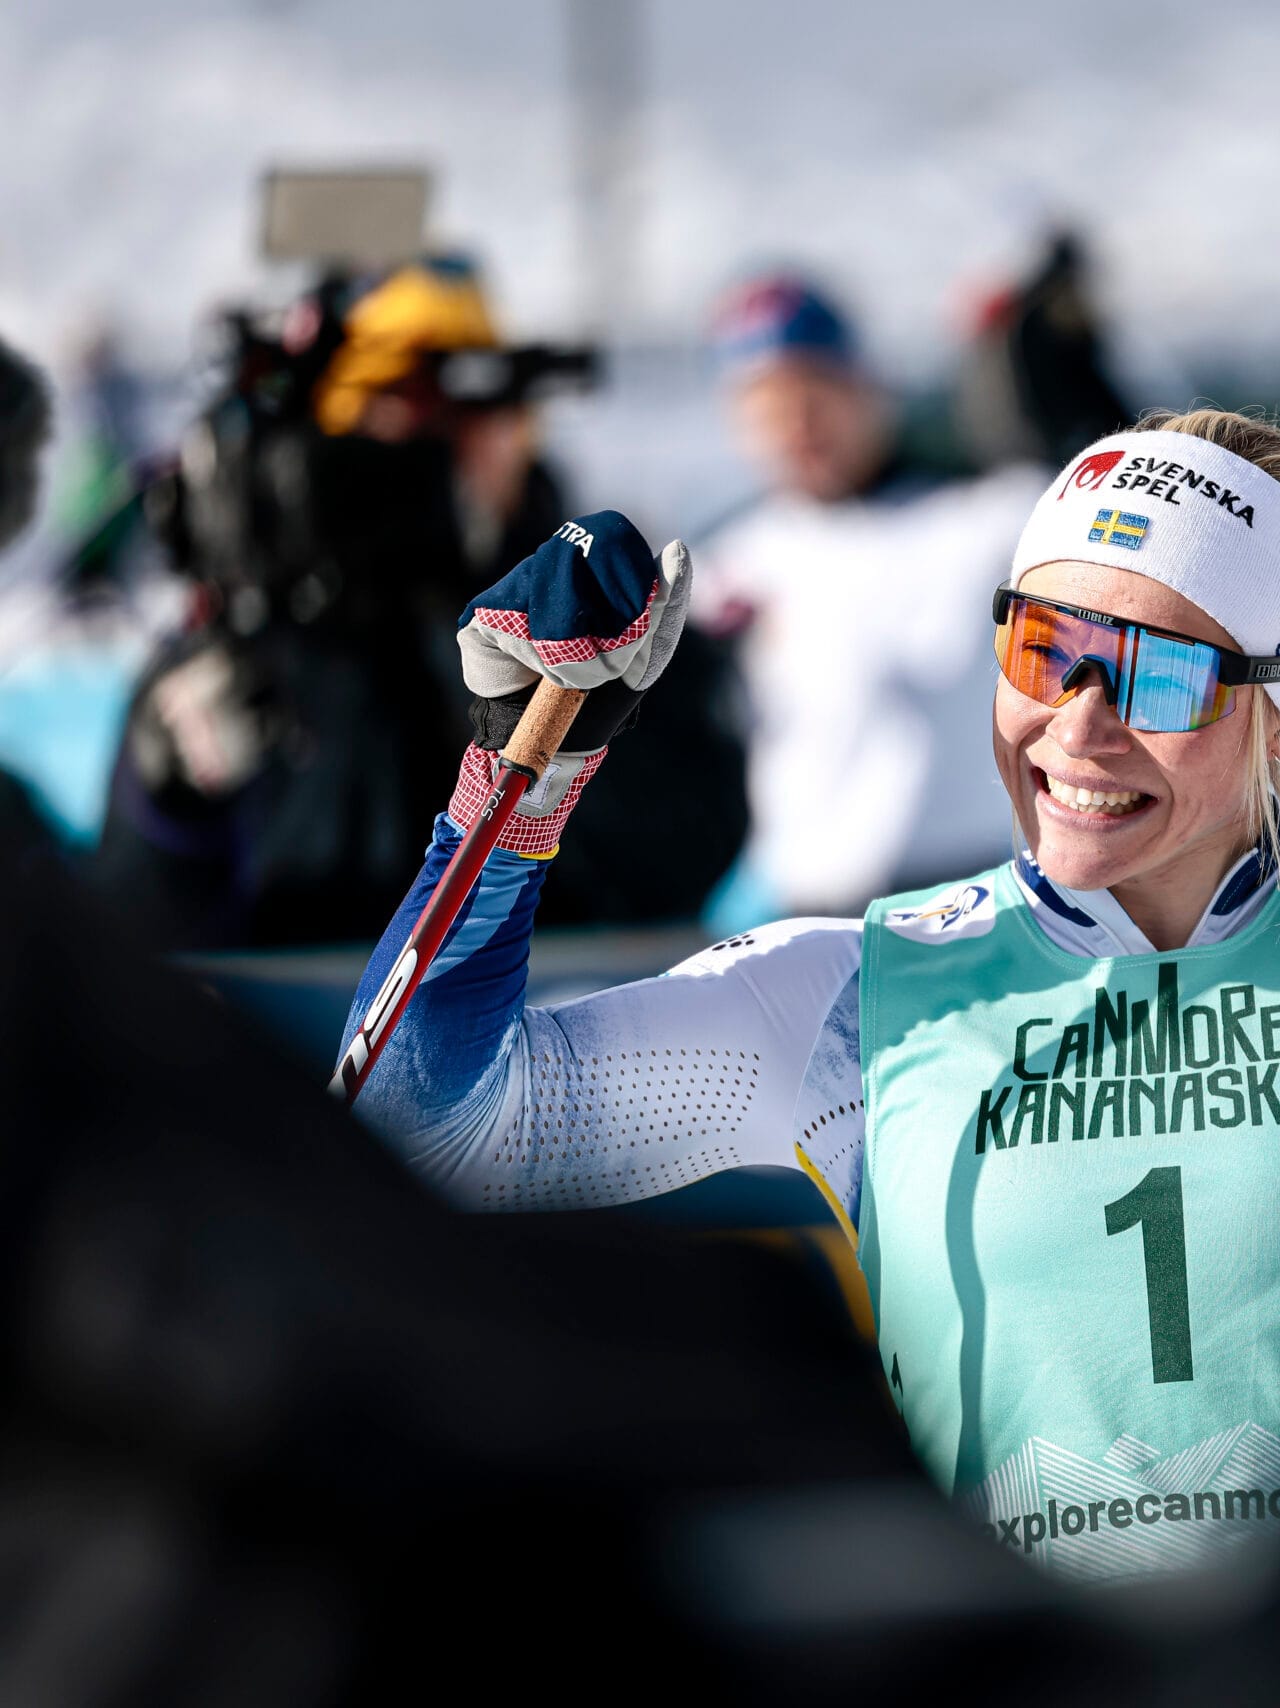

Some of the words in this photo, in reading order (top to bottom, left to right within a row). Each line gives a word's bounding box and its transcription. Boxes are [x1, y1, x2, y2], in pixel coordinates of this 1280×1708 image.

[1112, 473, 1181, 505] SPEL
[1125, 457, 1255, 528] SVENSKA
[481, 787, 506, 821] TCS
[1104, 1166, 1194, 1385] 1
